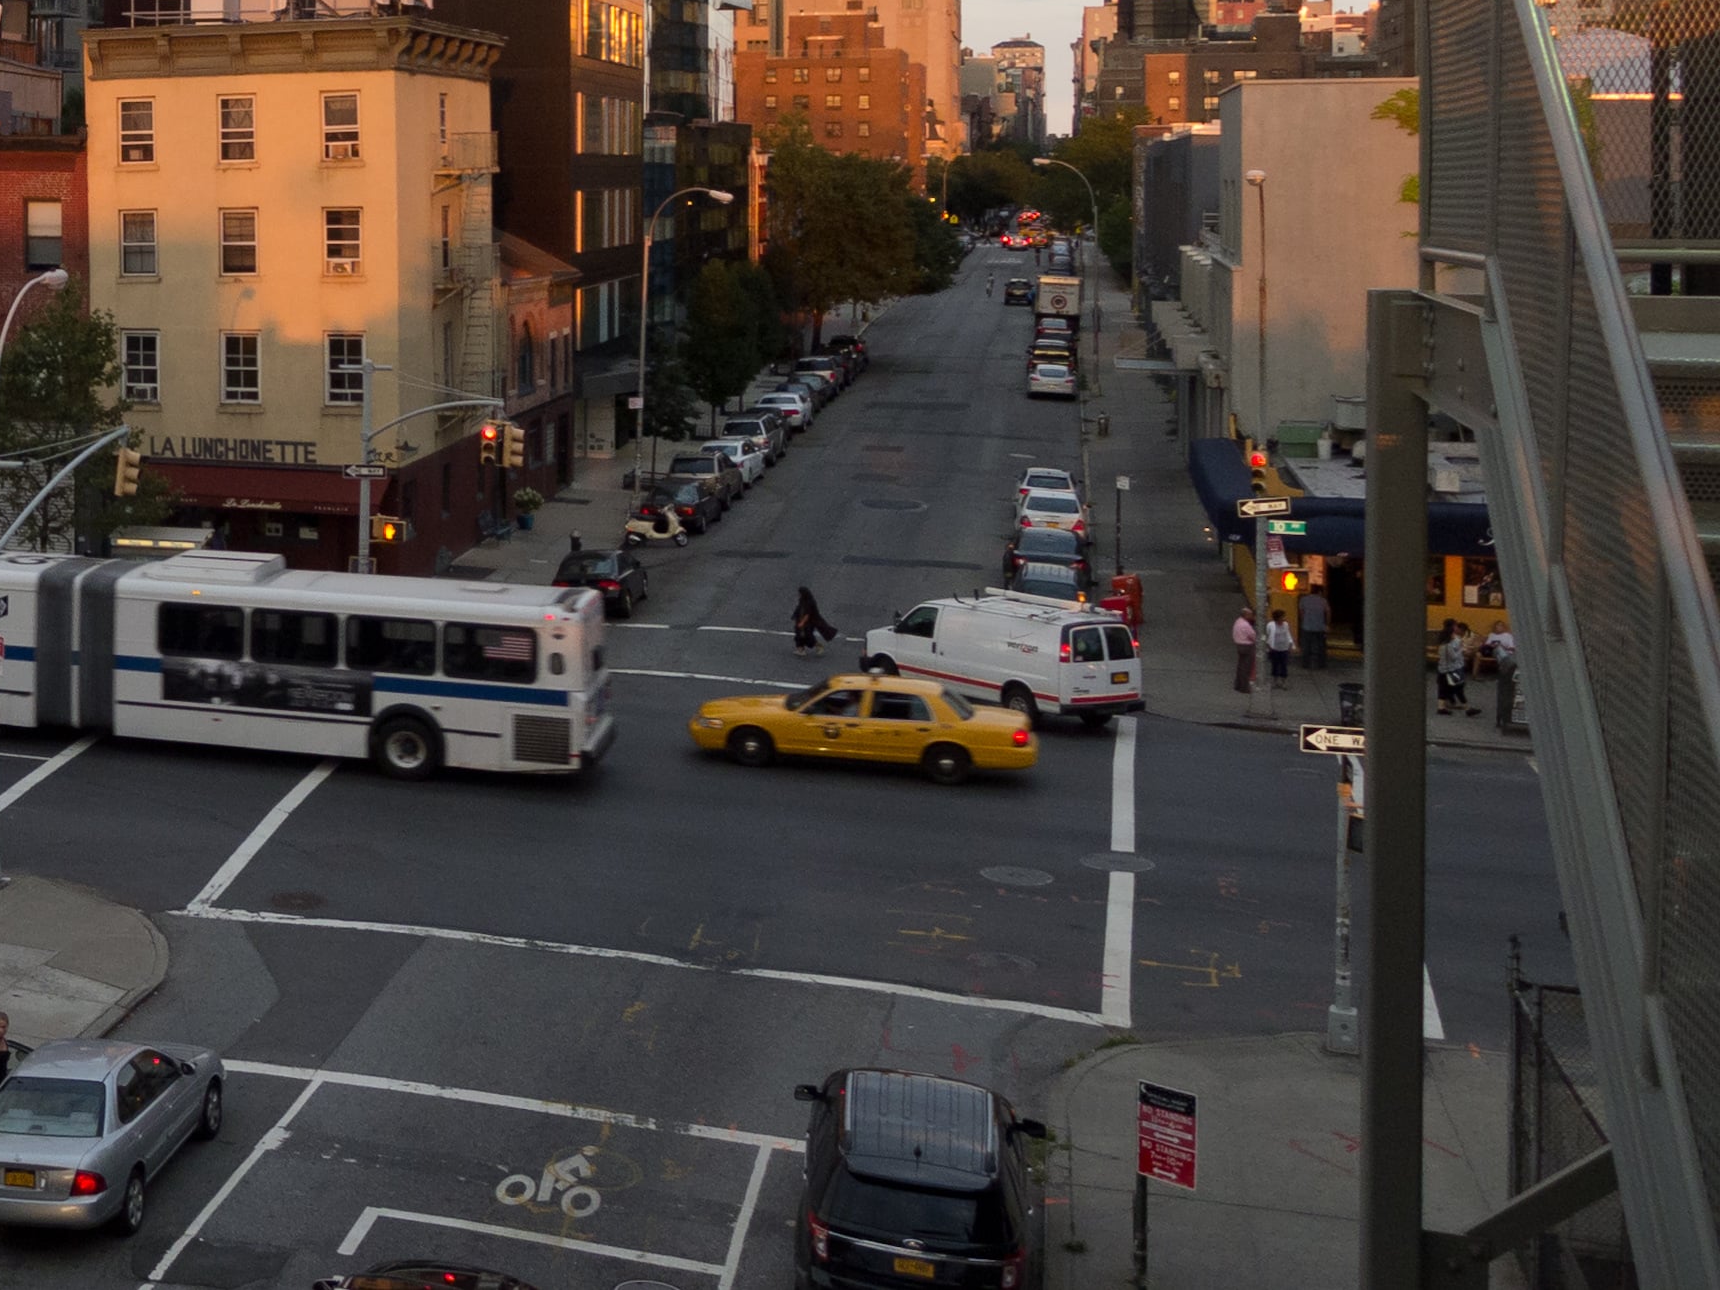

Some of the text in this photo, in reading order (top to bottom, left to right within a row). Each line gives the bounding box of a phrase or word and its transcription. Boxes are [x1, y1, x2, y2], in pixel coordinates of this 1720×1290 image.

[150, 436, 317, 464] LA LUNCHONETTE
[1315, 734, 1340, 745] ONE
[1142, 1105, 1193, 1126] NO STANDING
[1141, 1139, 1192, 1161] NO STANDING
